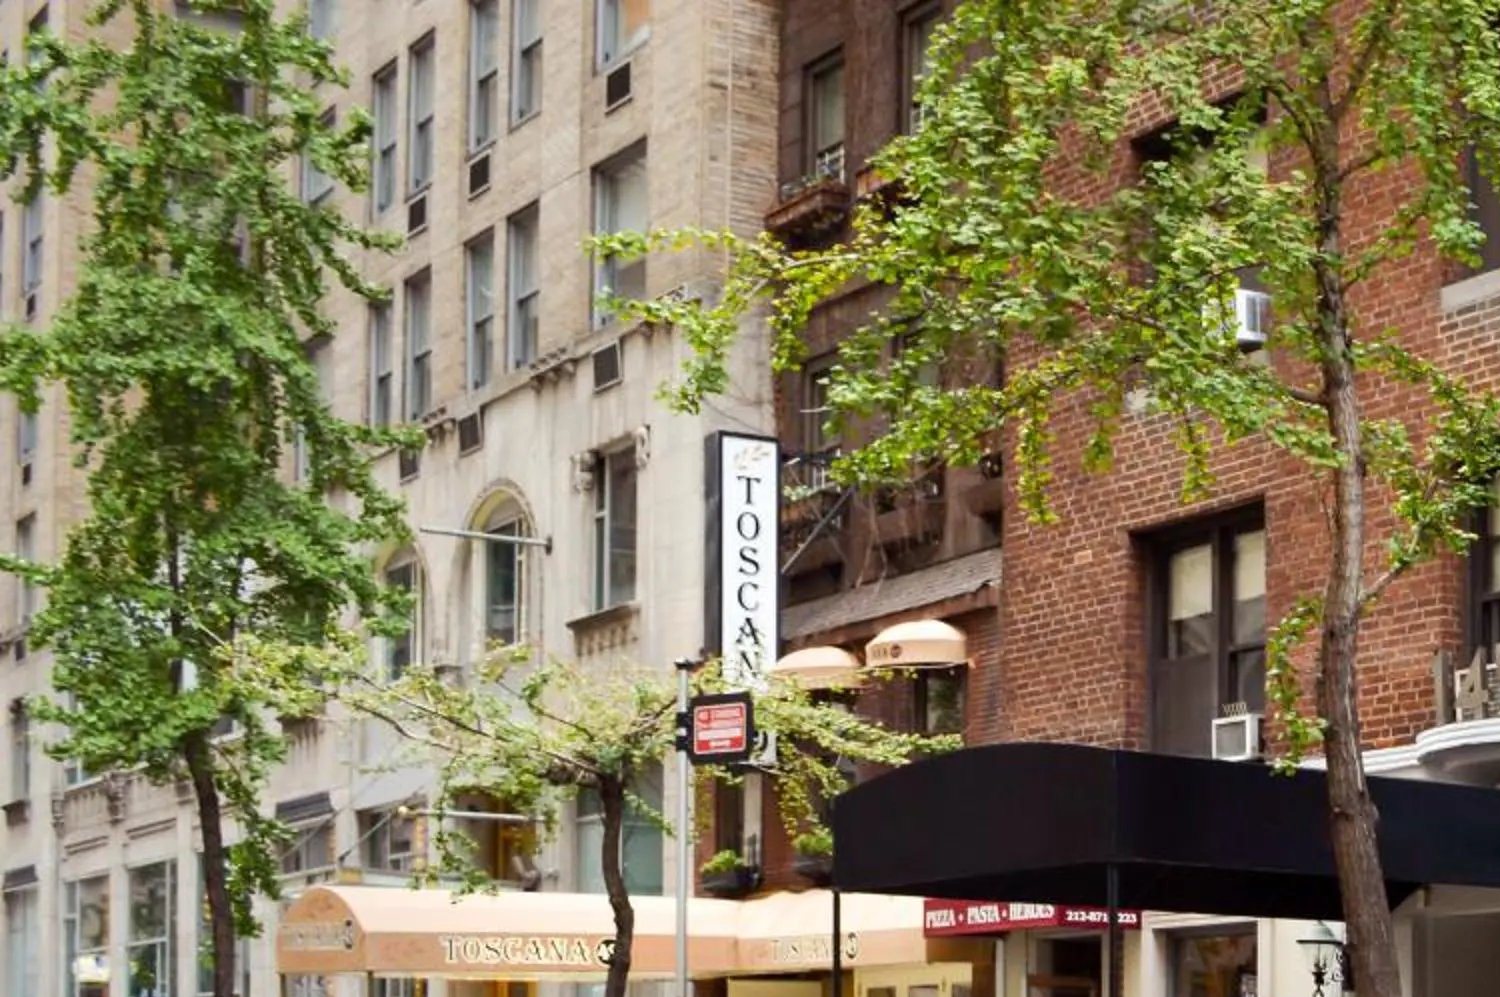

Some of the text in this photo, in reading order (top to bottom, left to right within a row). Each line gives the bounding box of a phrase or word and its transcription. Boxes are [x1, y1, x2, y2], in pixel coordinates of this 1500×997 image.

[736, 475, 763, 681] TOSCAN
[926, 908, 956, 929] PIZZA
[967, 904, 1001, 925] PASTA
[440, 936, 589, 963] TOSCANA
